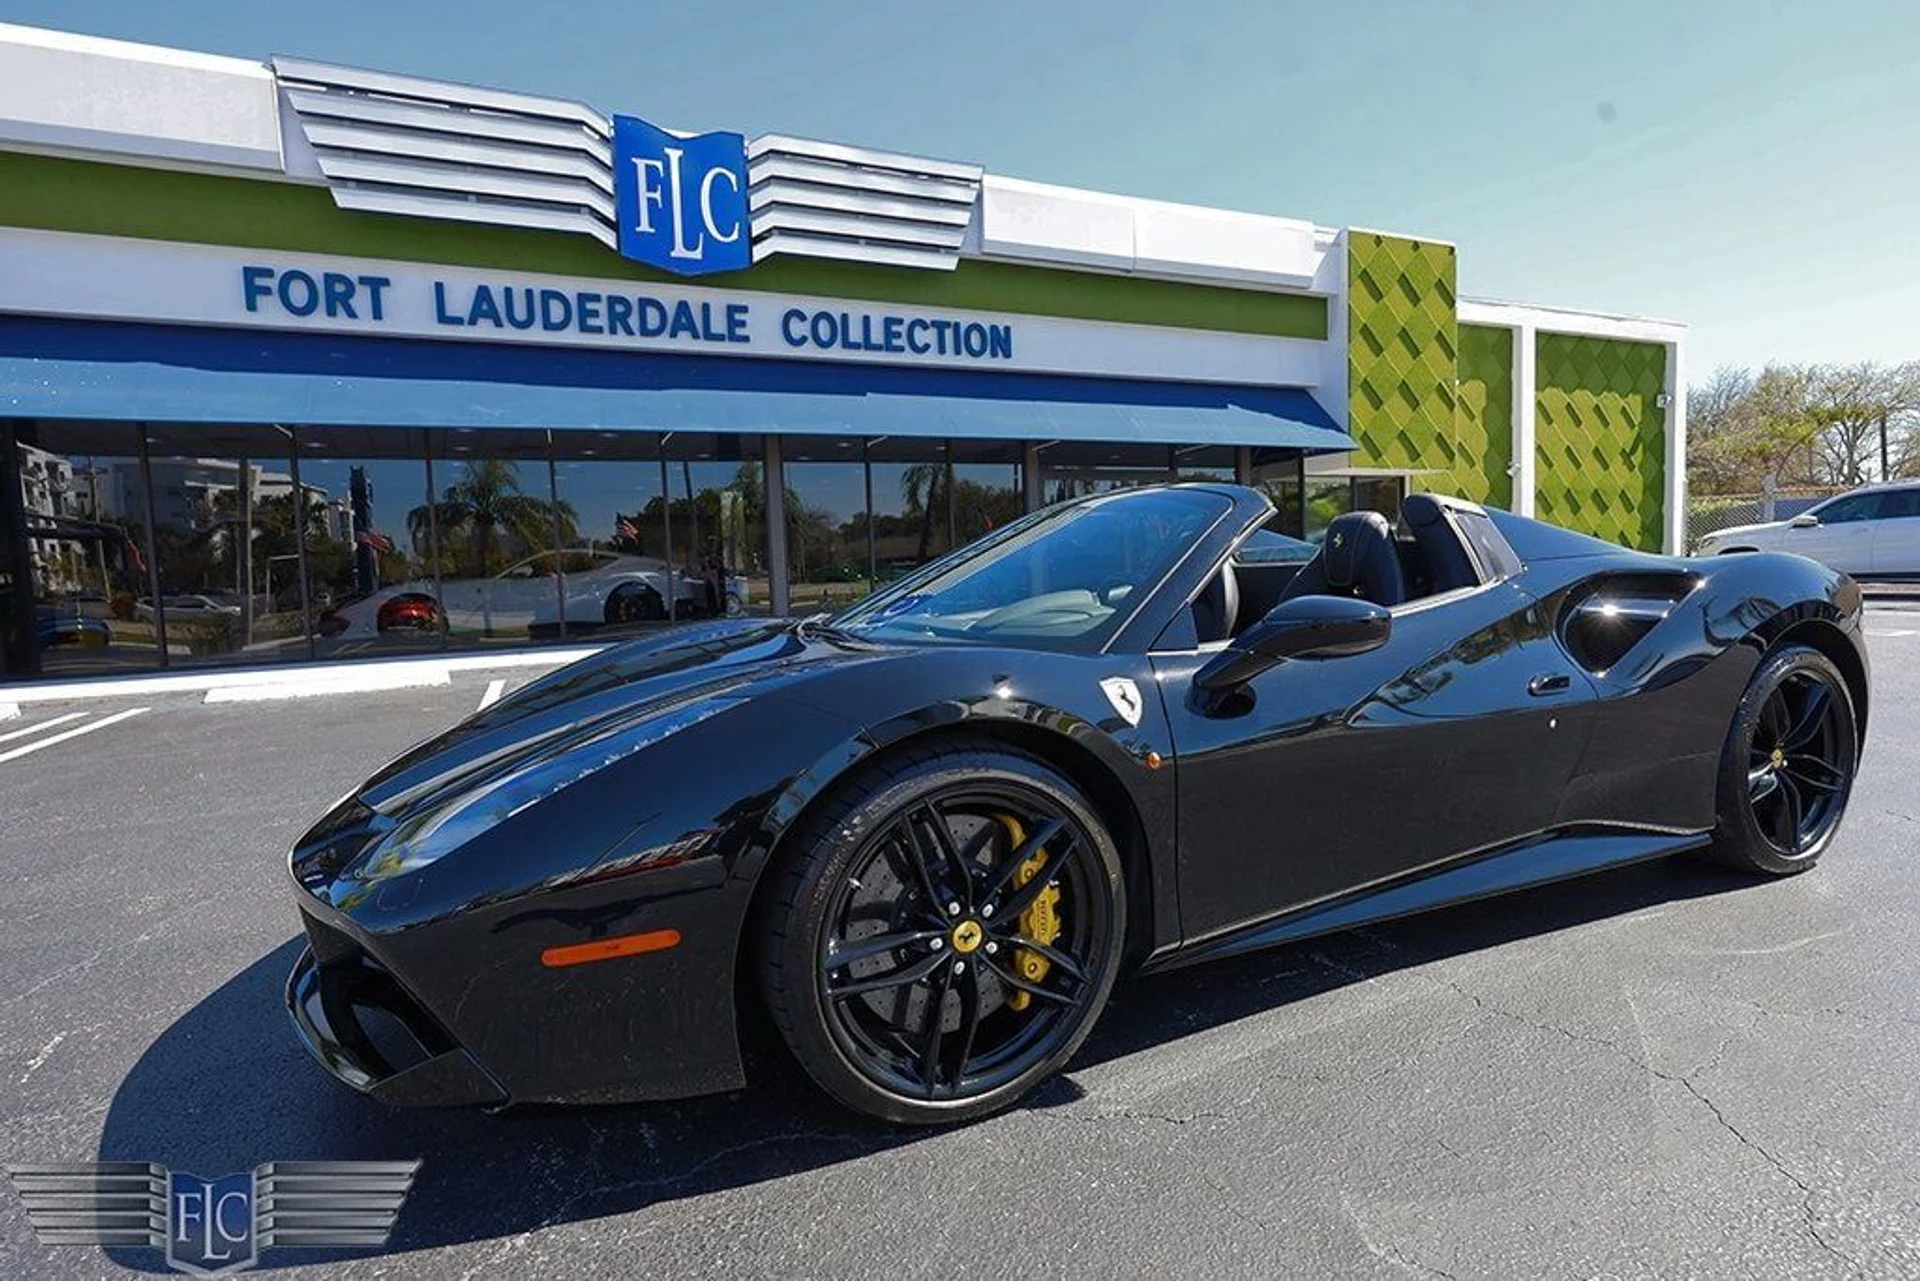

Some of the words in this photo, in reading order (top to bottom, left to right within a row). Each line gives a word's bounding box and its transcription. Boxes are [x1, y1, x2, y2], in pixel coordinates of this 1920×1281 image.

[631, 147, 739, 260] FLC
[242, 266, 391, 320] FORT
[434, 281, 749, 343] LAUDERDALE
[781, 309, 1012, 359] COLLECTION
